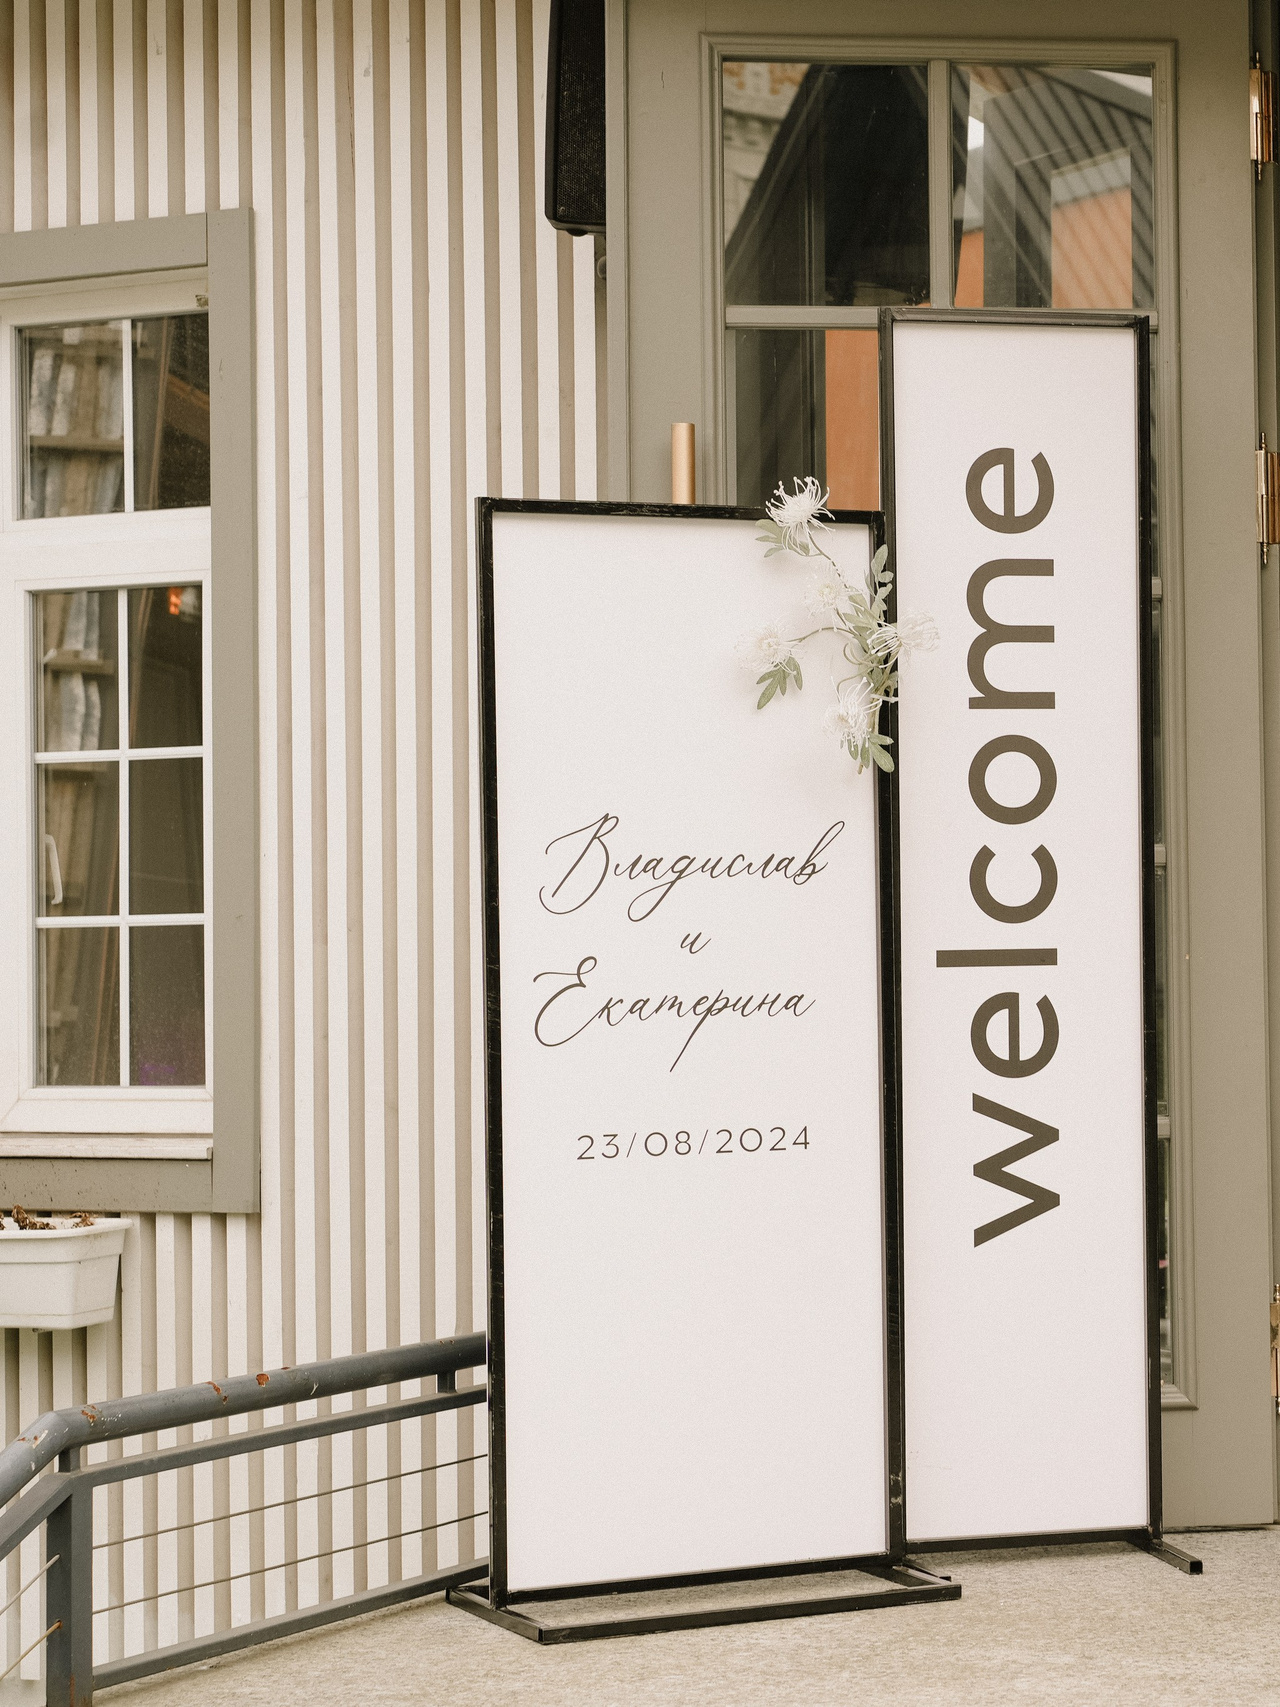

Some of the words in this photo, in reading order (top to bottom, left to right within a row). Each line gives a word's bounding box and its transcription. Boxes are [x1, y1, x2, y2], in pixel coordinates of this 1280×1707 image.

[539, 812, 845, 922] Владислав
[936, 446, 1061, 1248] welcome
[680, 932, 712, 954] и
[533, 955, 816, 1073] Екатерина
[576, 1126, 811, 1161] 23/08/2024
